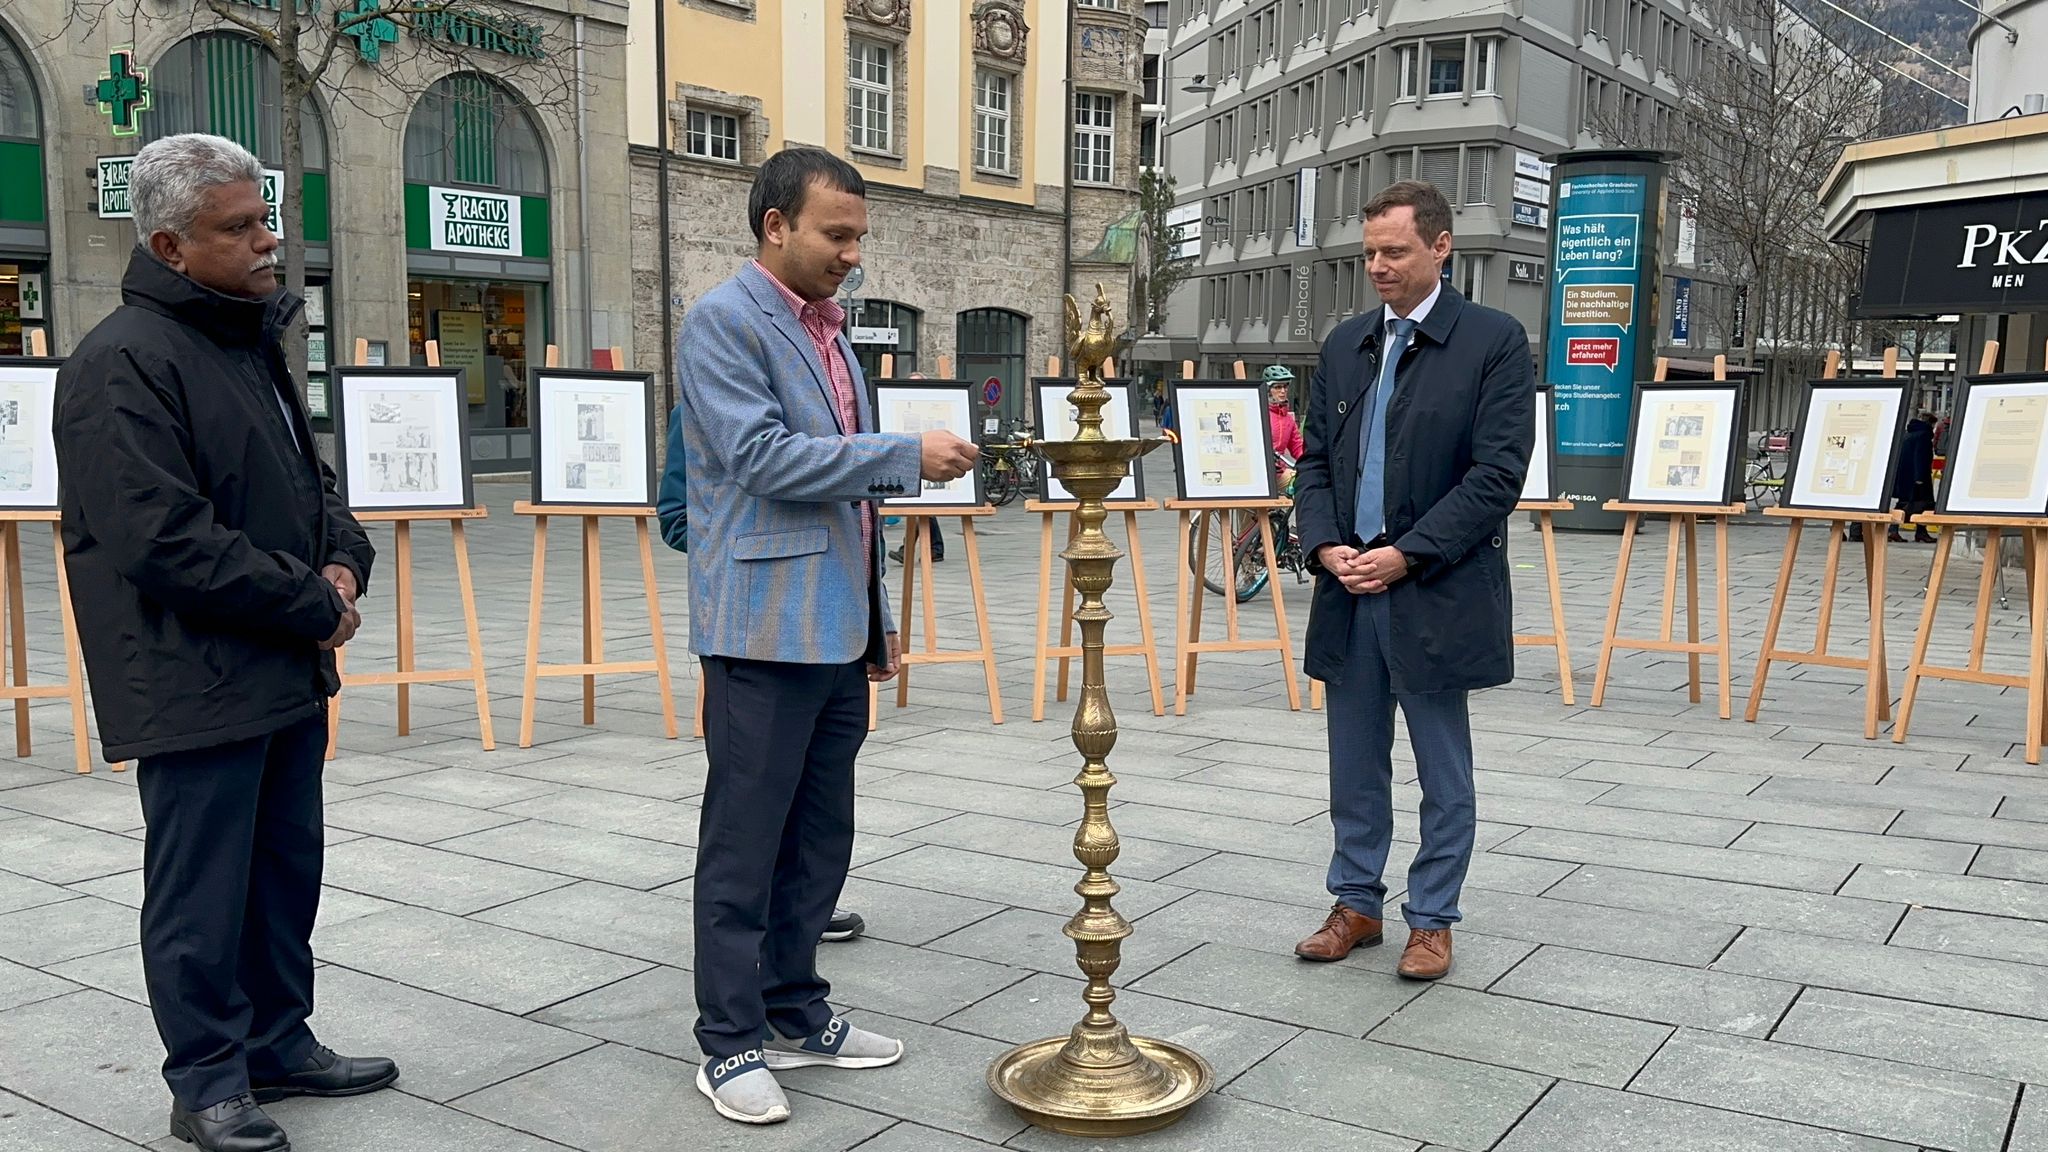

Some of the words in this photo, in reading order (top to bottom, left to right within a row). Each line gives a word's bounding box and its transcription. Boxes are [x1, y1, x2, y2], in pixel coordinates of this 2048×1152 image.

[1572, 182, 1608, 190] Fachhochschule
[104, 190, 131, 211] APOTH
[462, 197, 508, 221] RAETUS
[447, 222, 508, 247] APOTHEKE
[1562, 225, 1581, 235] Was
[1584, 223, 1605, 233] hält
[1561, 236, 1611, 249] eigentlich
[1614, 236, 1631, 246] ein
[1561, 250, 1589, 261] Leben
[1592, 249, 1623, 262] lang?
[1992, 274, 2024, 288] MEN
[1295, 265, 1310, 336] Buchcafé
[1567, 291, 1579, 299] Ein
[1580, 290, 1619, 299] Studium.
[1566, 301, 1579, 309] Die
[1580, 300, 1630, 310] nachhaltige
[1566, 310, 1611, 318] Investition.
[1571, 351, 1606, 359] erfahren!
